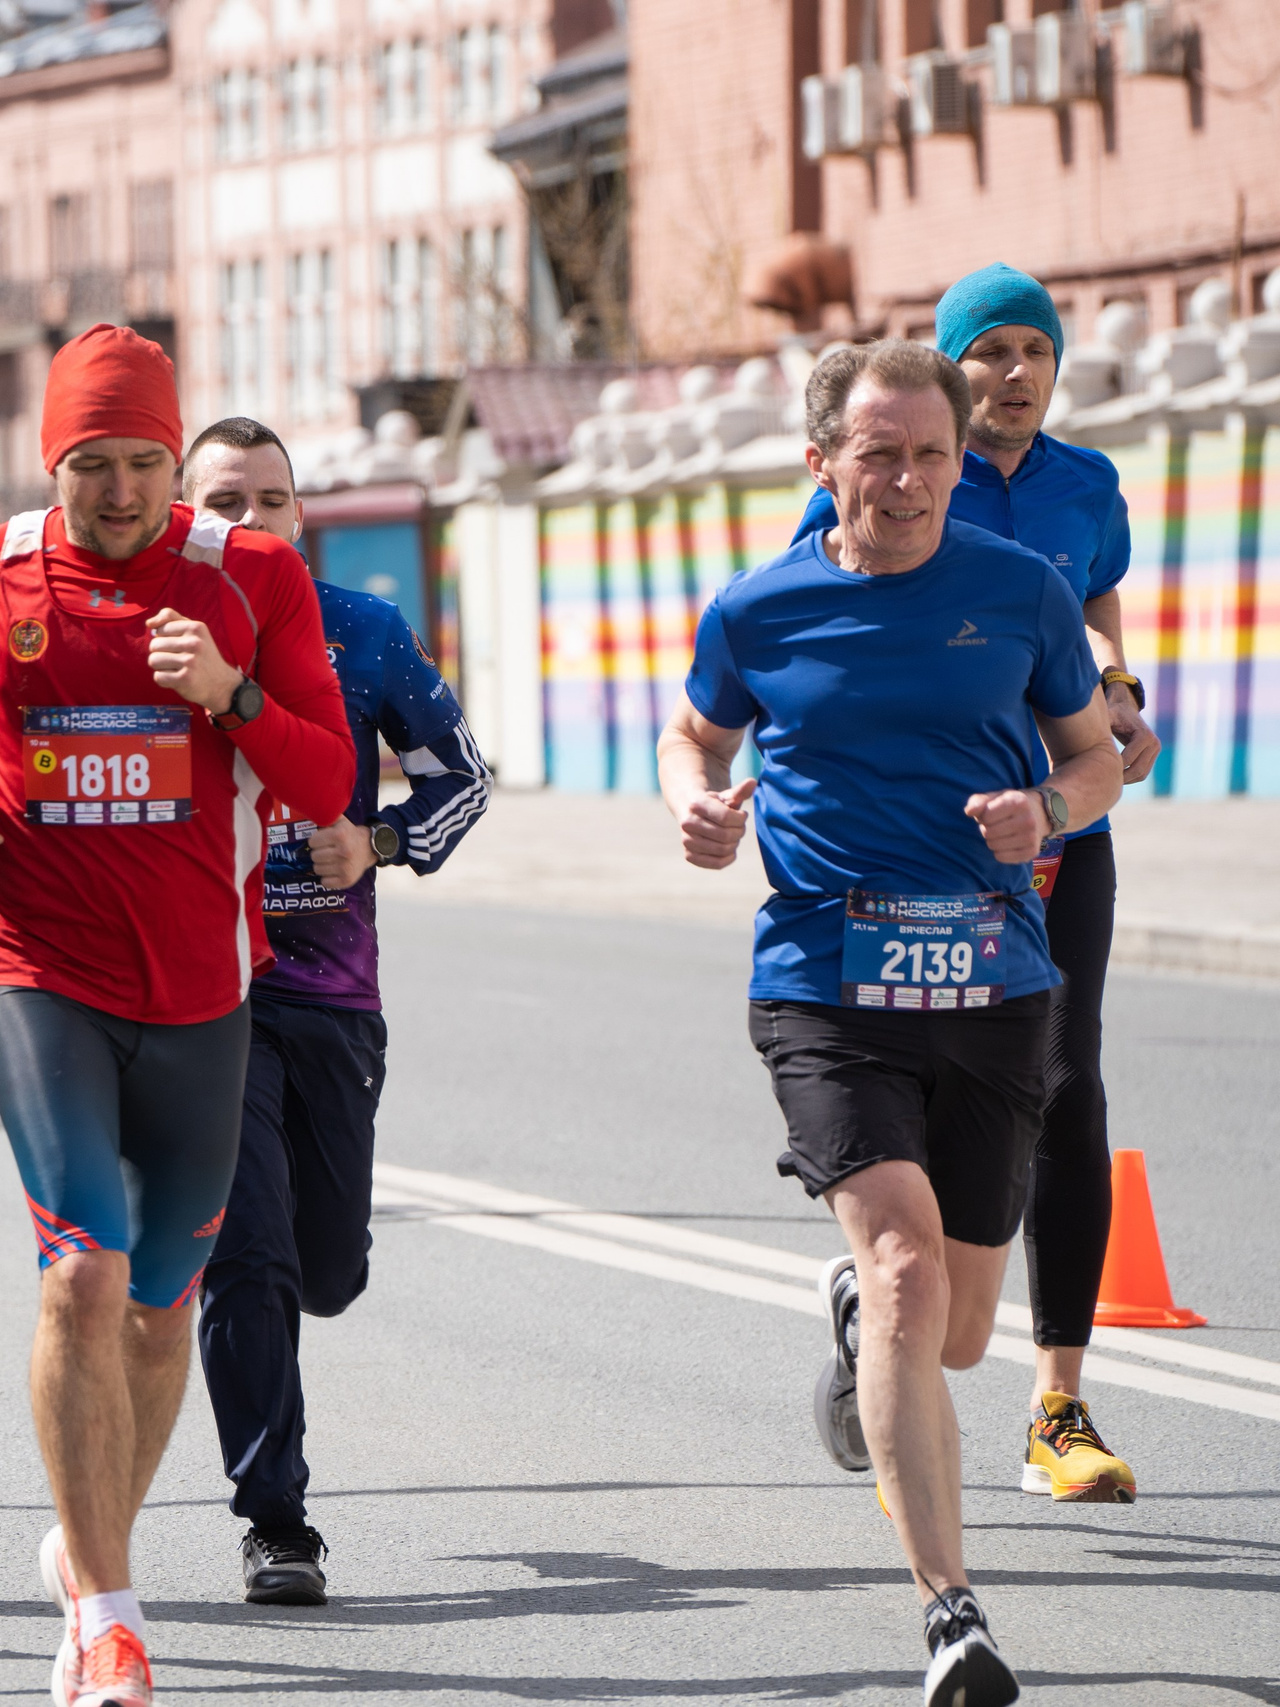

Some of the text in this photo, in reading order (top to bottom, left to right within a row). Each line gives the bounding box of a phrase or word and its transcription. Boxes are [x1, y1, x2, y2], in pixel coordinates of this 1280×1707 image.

[947, 637, 988, 646] DEMIX
[71, 712, 138, 720] Я ПРОСТО
[71, 719, 138, 729] КОСМОС
[61, 753, 151, 797] 1818
[898, 901, 964, 910] Я ПРОСТО
[897, 909, 964, 918] КОСМОС
[852, 923, 867, 931] 21,1
[899, 925, 953, 936] ВЯЧЕСЛАВ
[880, 940, 973, 983] 2139
